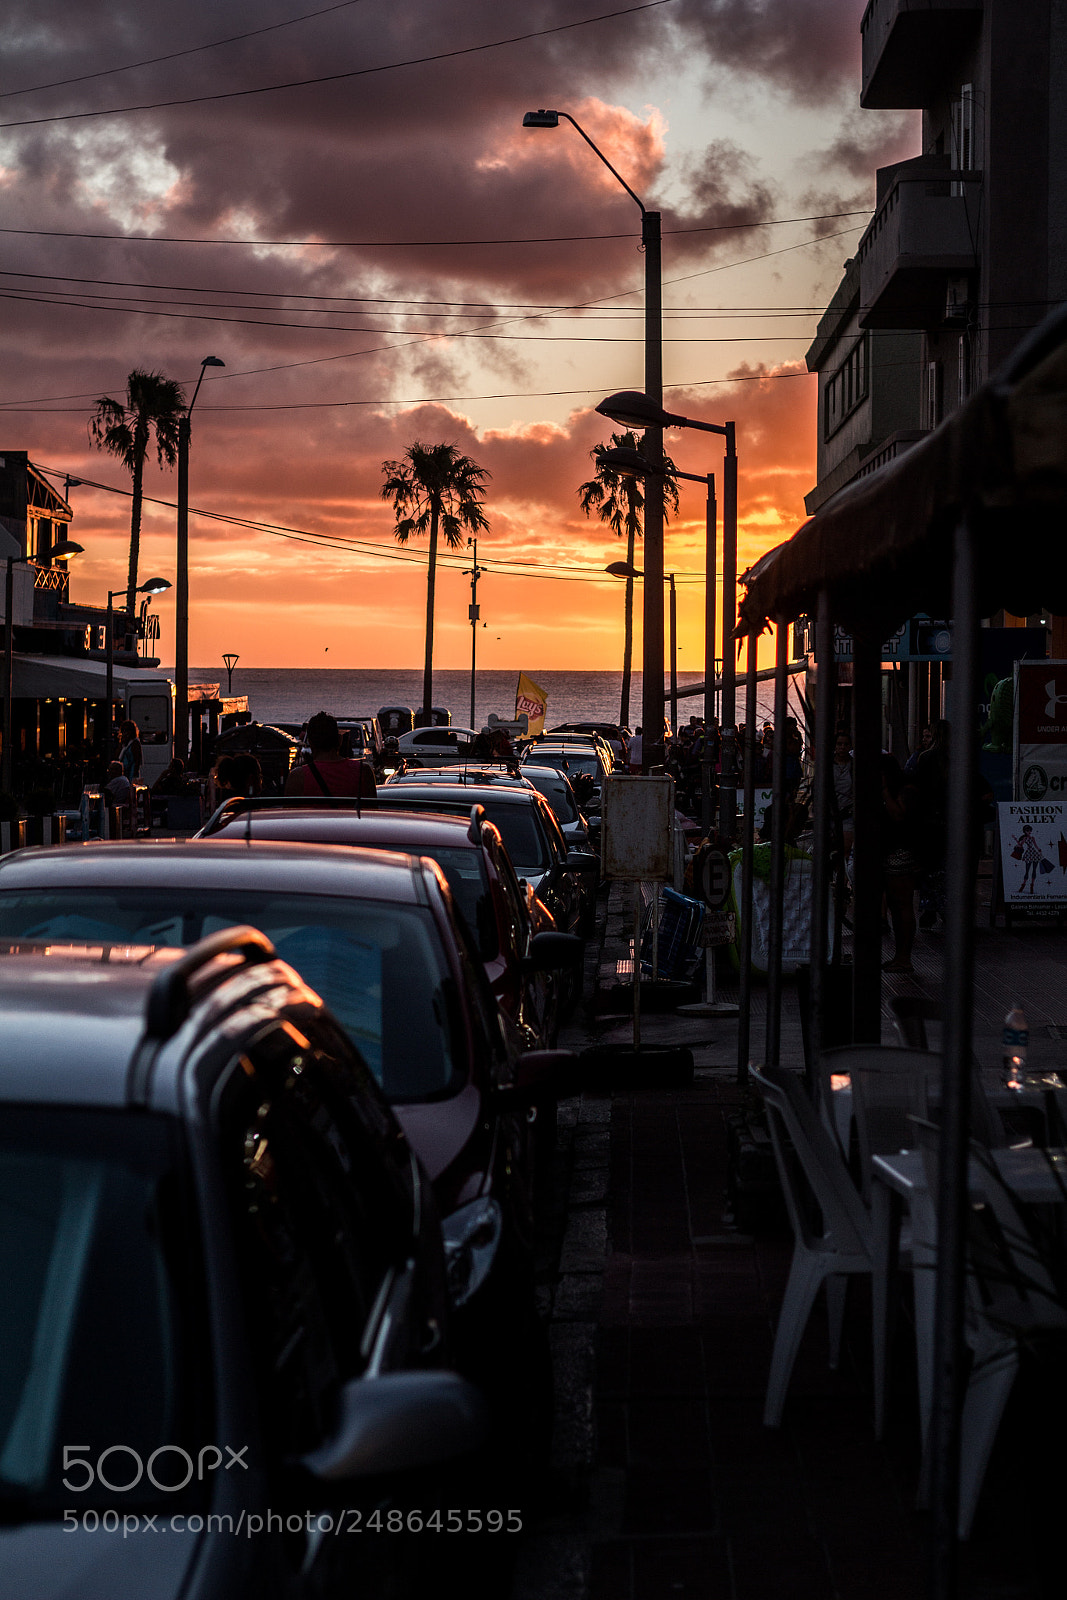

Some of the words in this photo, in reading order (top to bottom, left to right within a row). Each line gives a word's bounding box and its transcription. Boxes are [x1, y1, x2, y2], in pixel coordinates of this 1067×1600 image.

[1037, 725, 1060, 733] UNDER
[1009, 806, 1063, 815] FASHION
[1017, 815, 1057, 824] ALLEY
